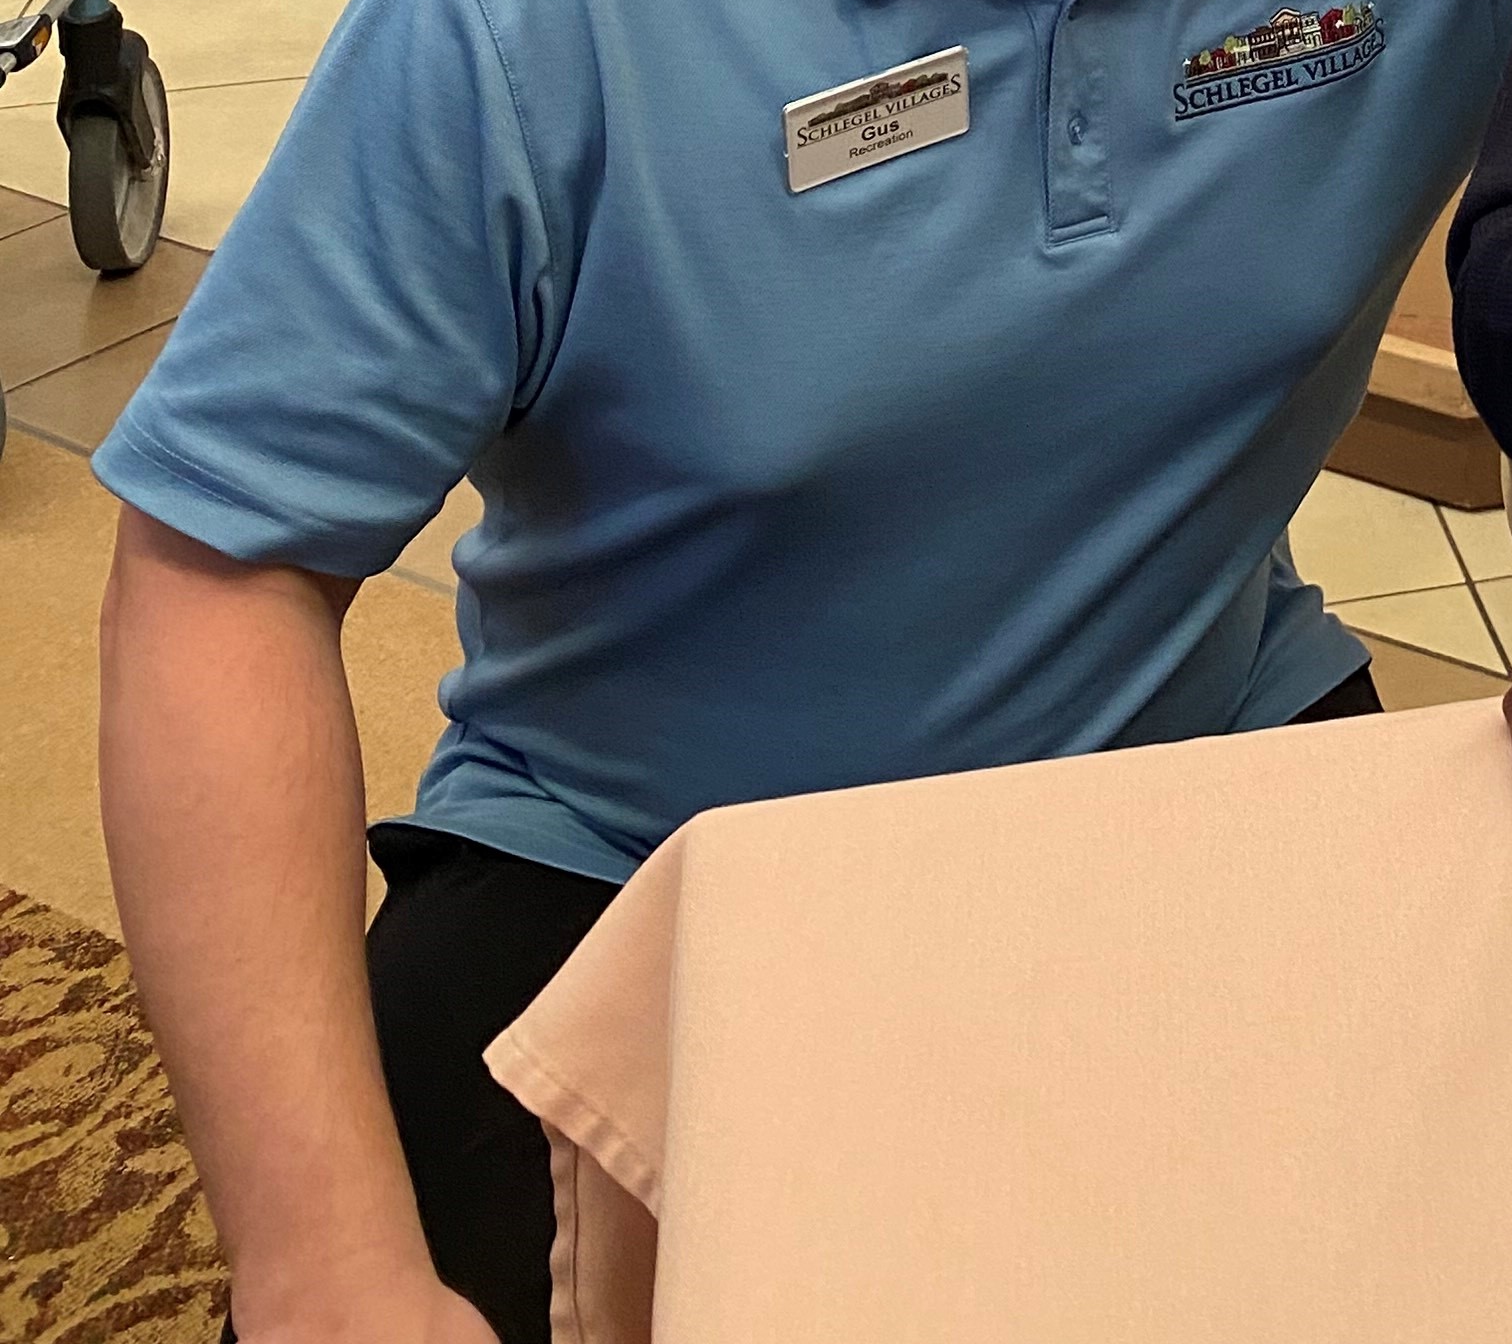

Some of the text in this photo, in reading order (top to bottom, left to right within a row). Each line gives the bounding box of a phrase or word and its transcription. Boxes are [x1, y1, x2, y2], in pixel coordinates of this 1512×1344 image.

[1173, 18, 1385, 114] SCHLEGEL VILLAGES
[797, 73, 962, 147] SCHLEGEL VILLAGES
[861, 119, 900, 142] Gus
[849, 128, 914, 159] Recreation
